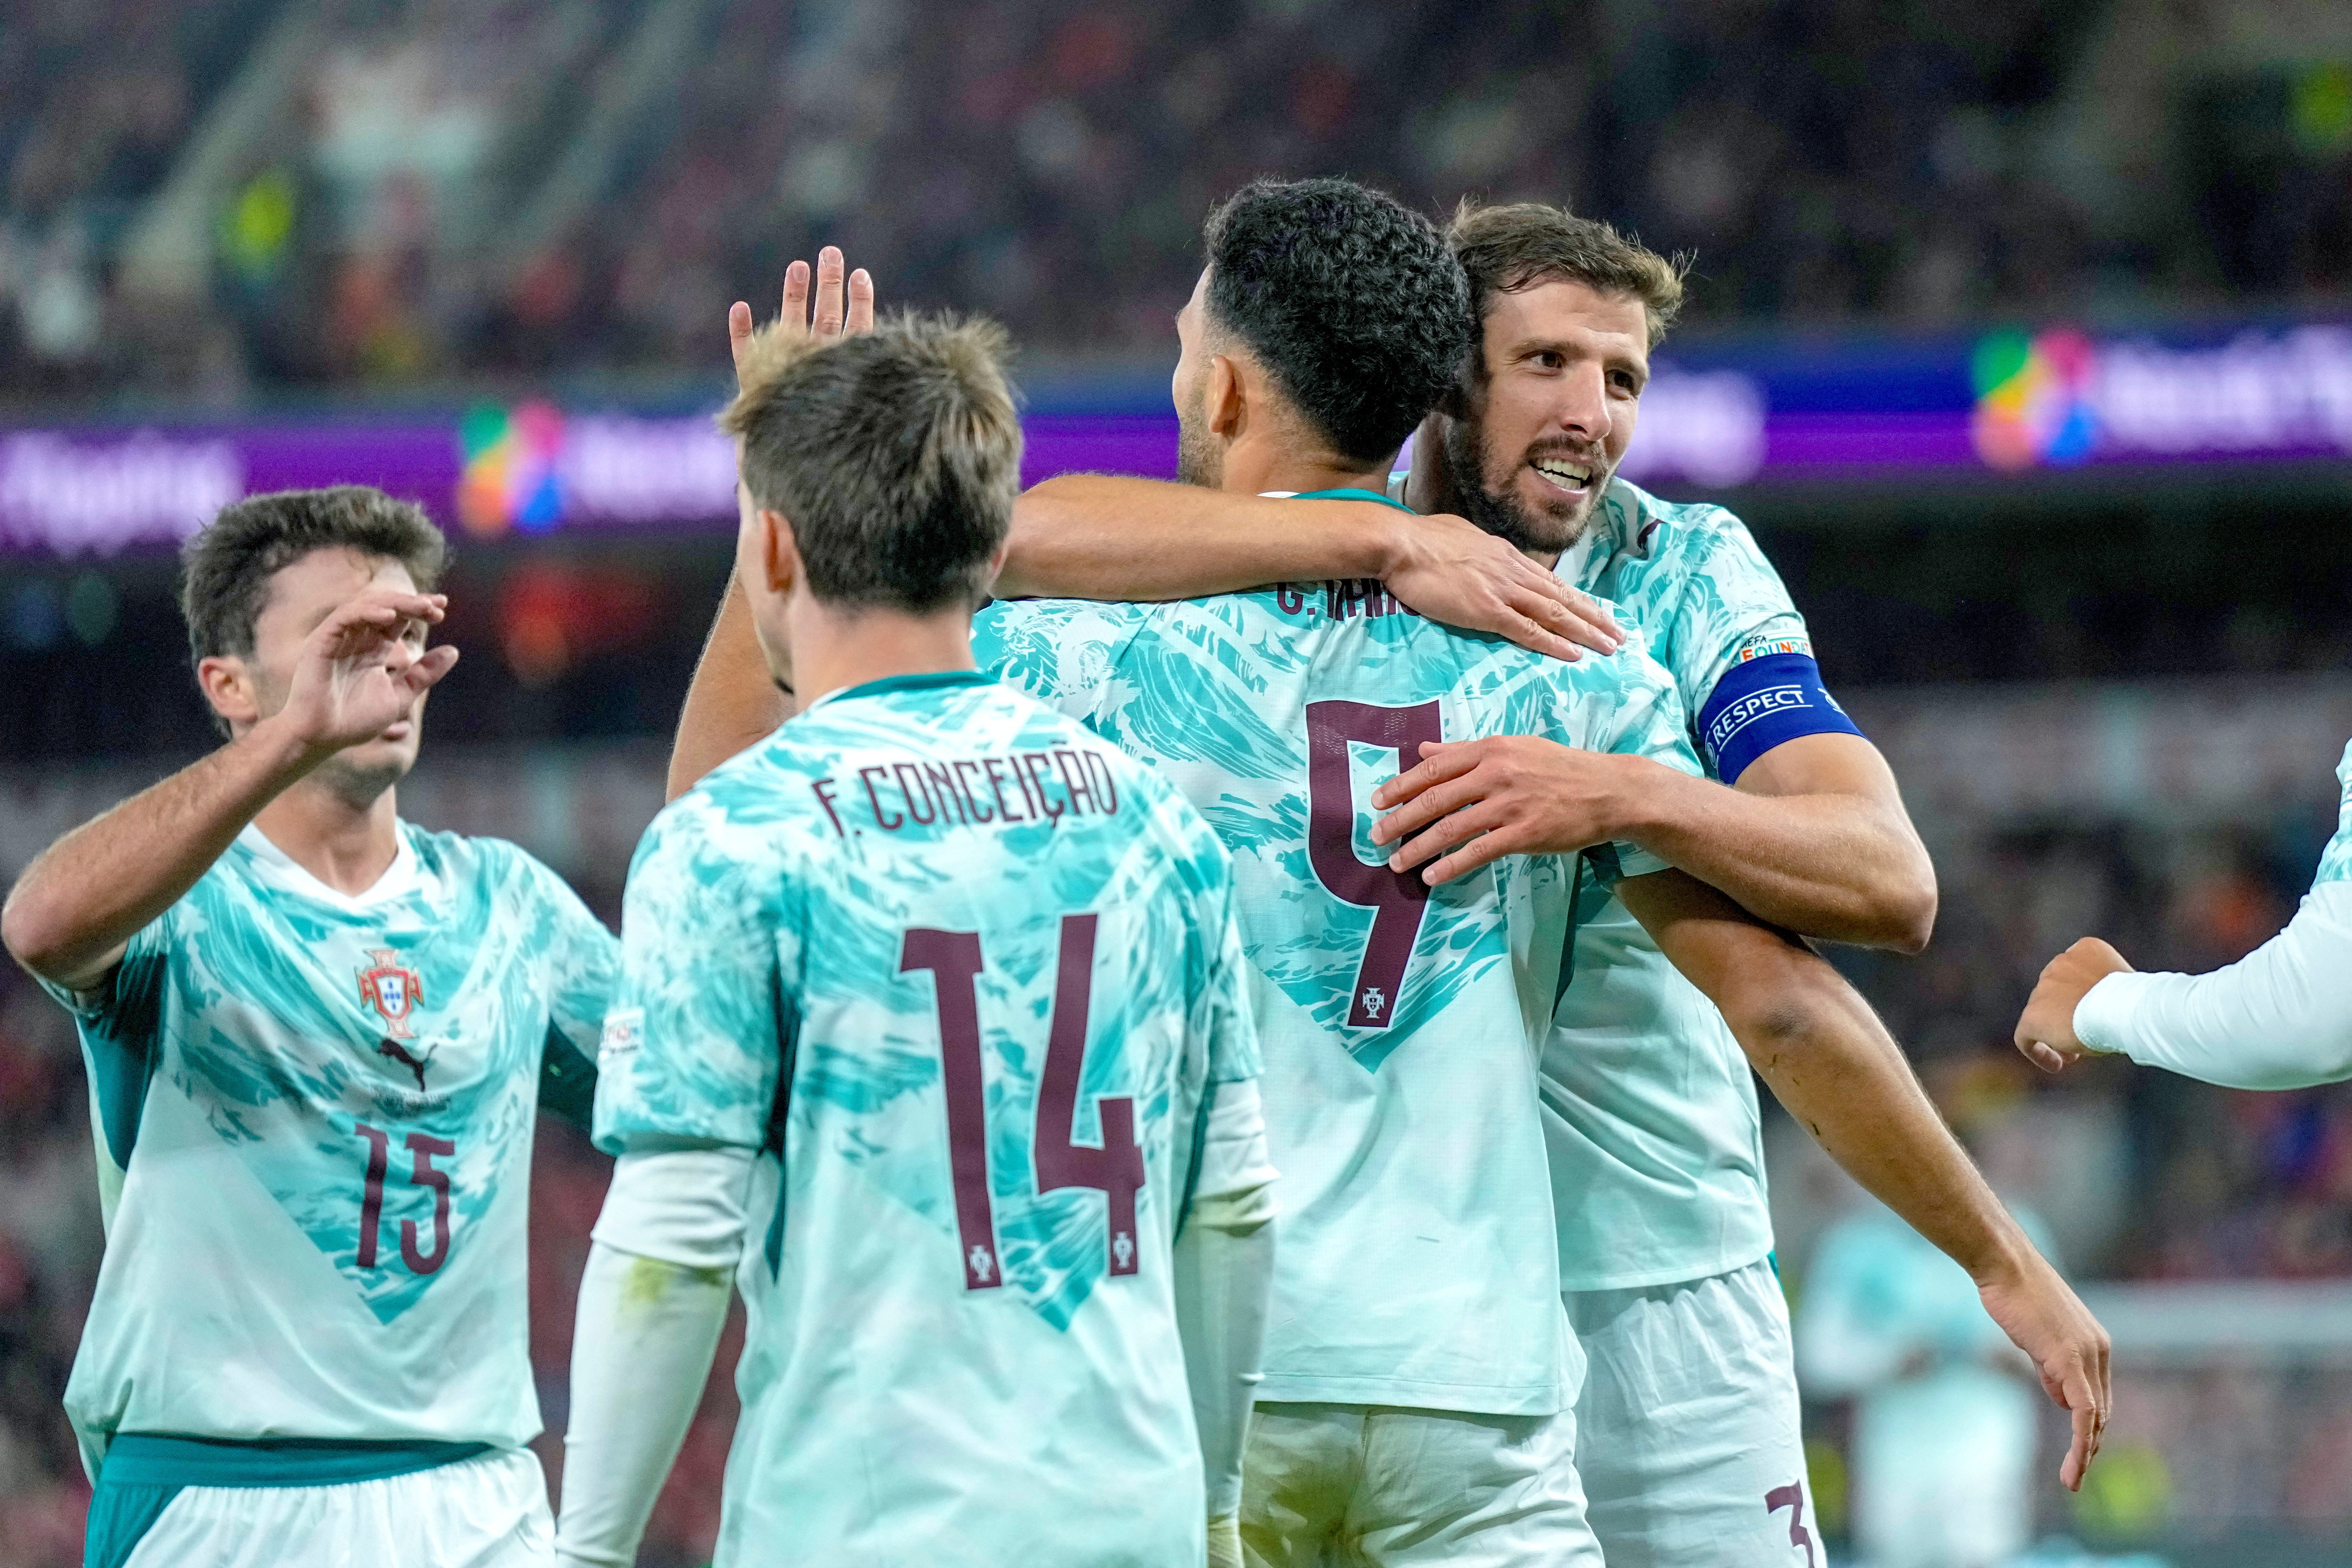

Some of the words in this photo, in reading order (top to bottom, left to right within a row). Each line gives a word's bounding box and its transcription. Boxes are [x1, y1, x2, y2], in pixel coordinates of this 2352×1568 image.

[1713, 691, 1804, 745] RESPECT
[811, 779, 862, 837] F.
[859, 741, 1117, 831] CONCEIÇÃO
[1306, 699, 1442, 1028] 9
[900, 913, 1146, 1289] 14
[355, 1123, 455, 1276] 15
[1764, 1478, 1815, 1568] 3
